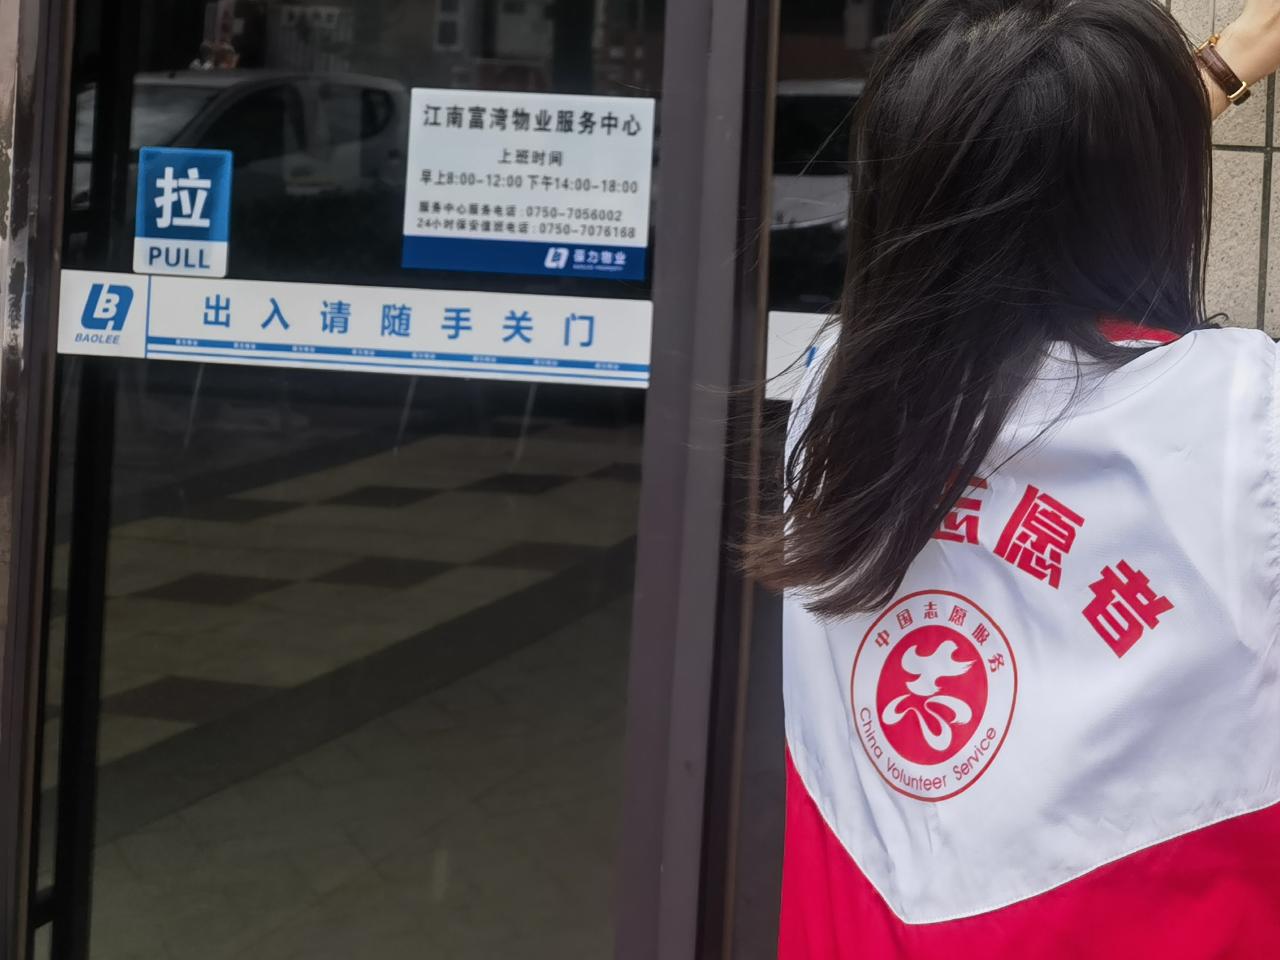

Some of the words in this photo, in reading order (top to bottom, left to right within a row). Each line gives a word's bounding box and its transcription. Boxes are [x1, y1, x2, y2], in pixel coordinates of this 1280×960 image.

[422, 104, 642, 137] 江南富湾物业服务中心
[498, 148, 564, 167] 上班时间
[155, 166, 211, 229] 拉
[148, 246, 211, 269] PULL
[75, 333, 120, 344] BAOLEE
[203, 294, 595, 347] 出入请随手关门
[874, 601, 1006, 674] 中国志愿服务
[859, 706, 884, 759] China
[886, 760, 948, 792] Volunteer
[953, 726, 997, 781] Service
